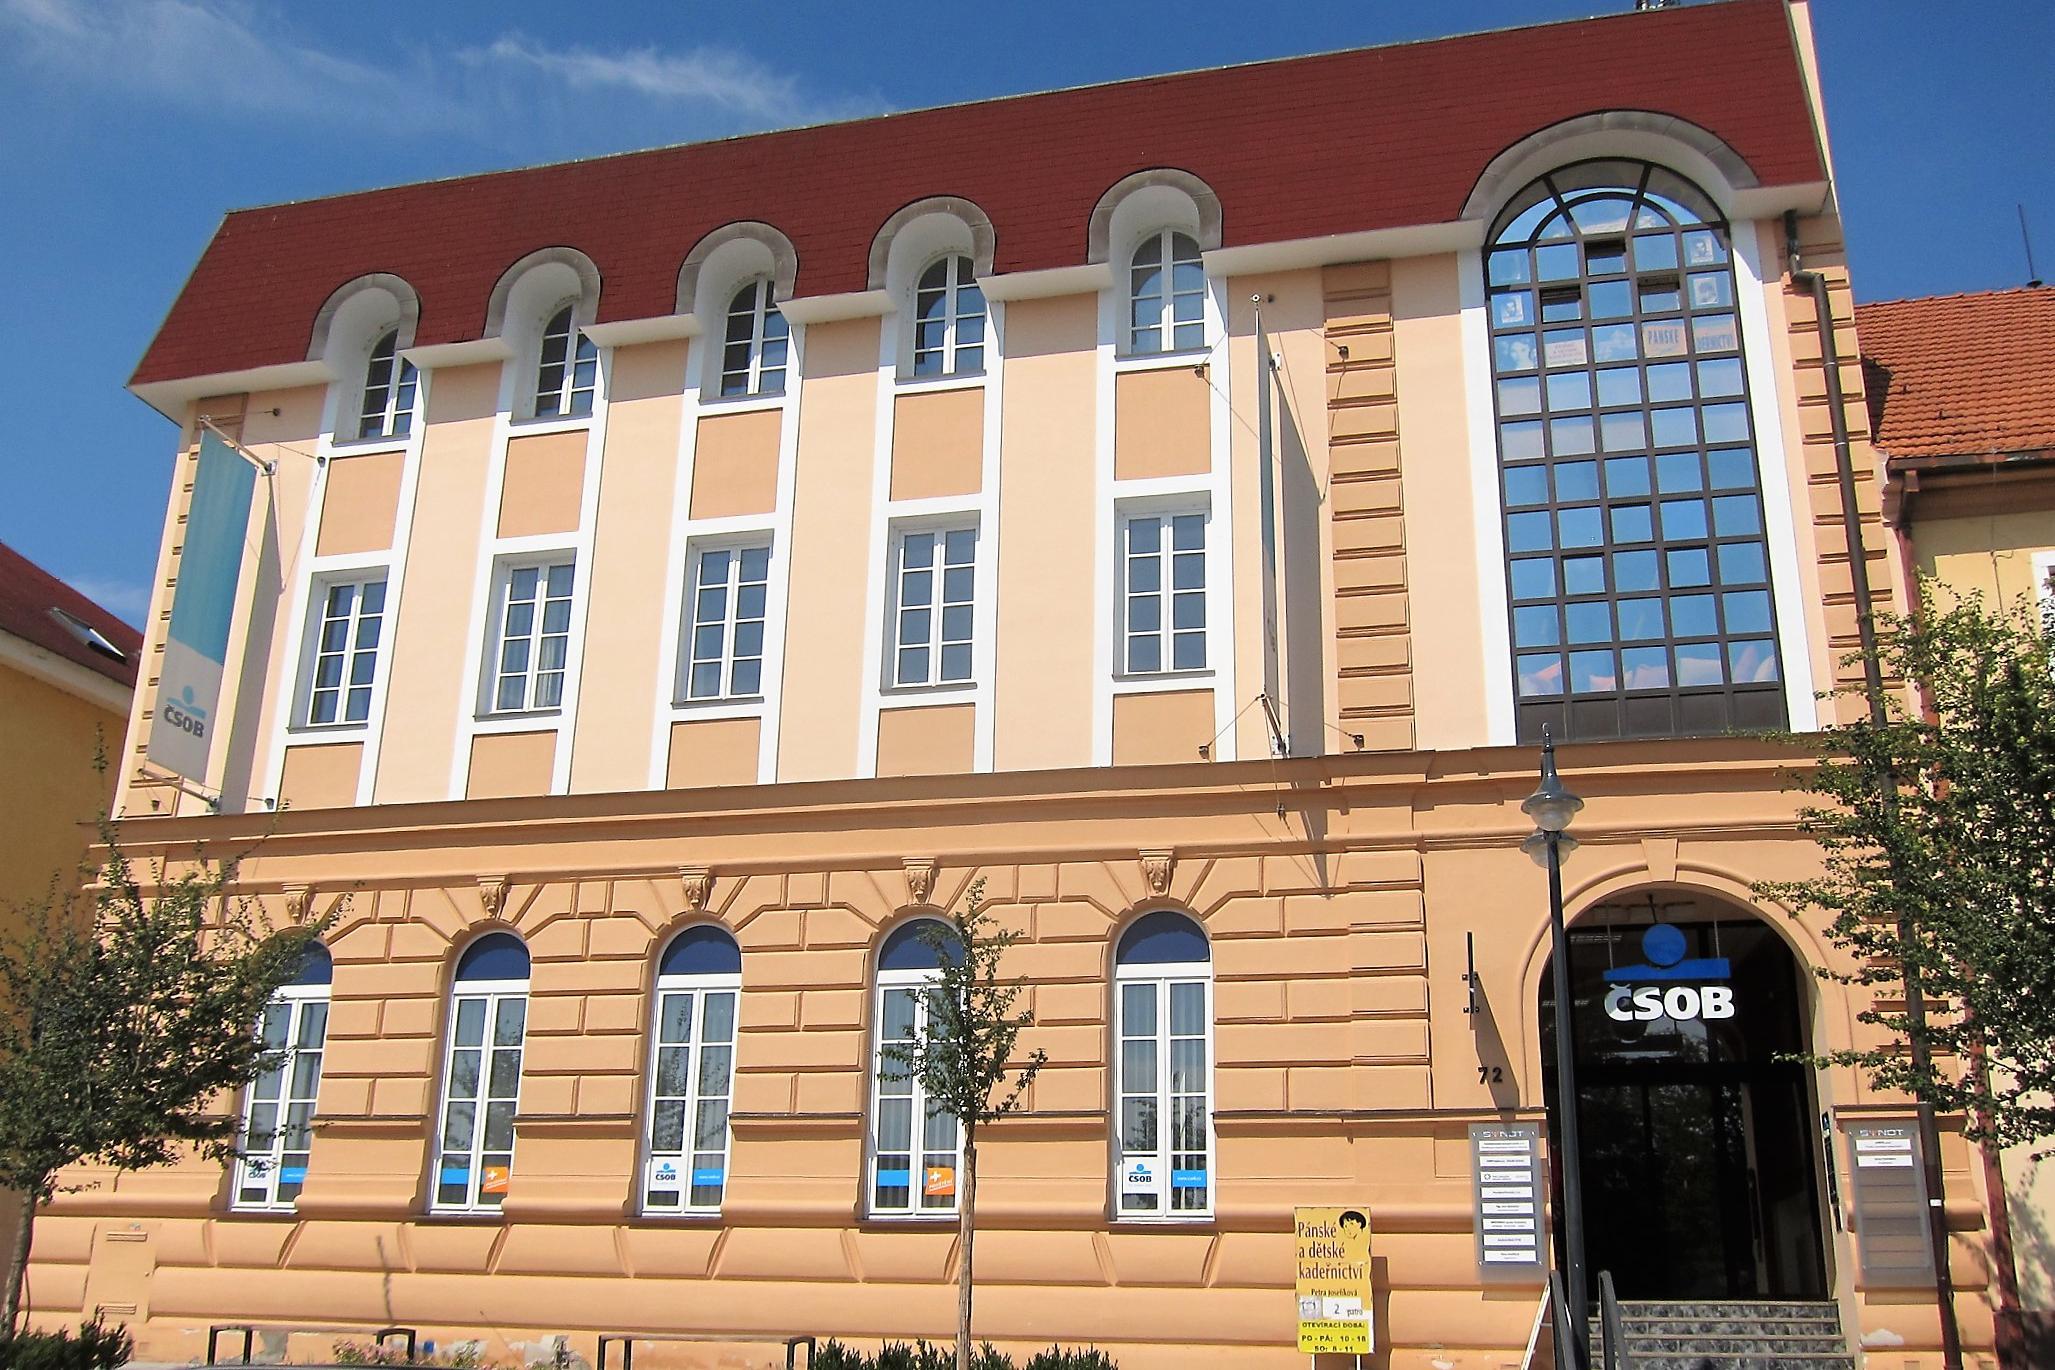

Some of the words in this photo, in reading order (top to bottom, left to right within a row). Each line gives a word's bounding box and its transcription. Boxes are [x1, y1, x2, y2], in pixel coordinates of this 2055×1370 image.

[165, 704, 205, 737] ČSOB
[1604, 983, 1736, 1022] ČSOB
[1477, 1066, 1504, 1085] 72
[1298, 1220, 1337, 1238] Pánské
[1298, 1246, 1305, 1259] a
[1308, 1241, 1345, 1259] dětské
[1299, 1261, 1363, 1280] kadeřnictví
[1311, 1288, 1327, 1296] Petra
[1334, 1303, 1340, 1315] 2
[1346, 1308, 1363, 1317] patro
[1319, 1334, 1333, 1342] PÁ:
